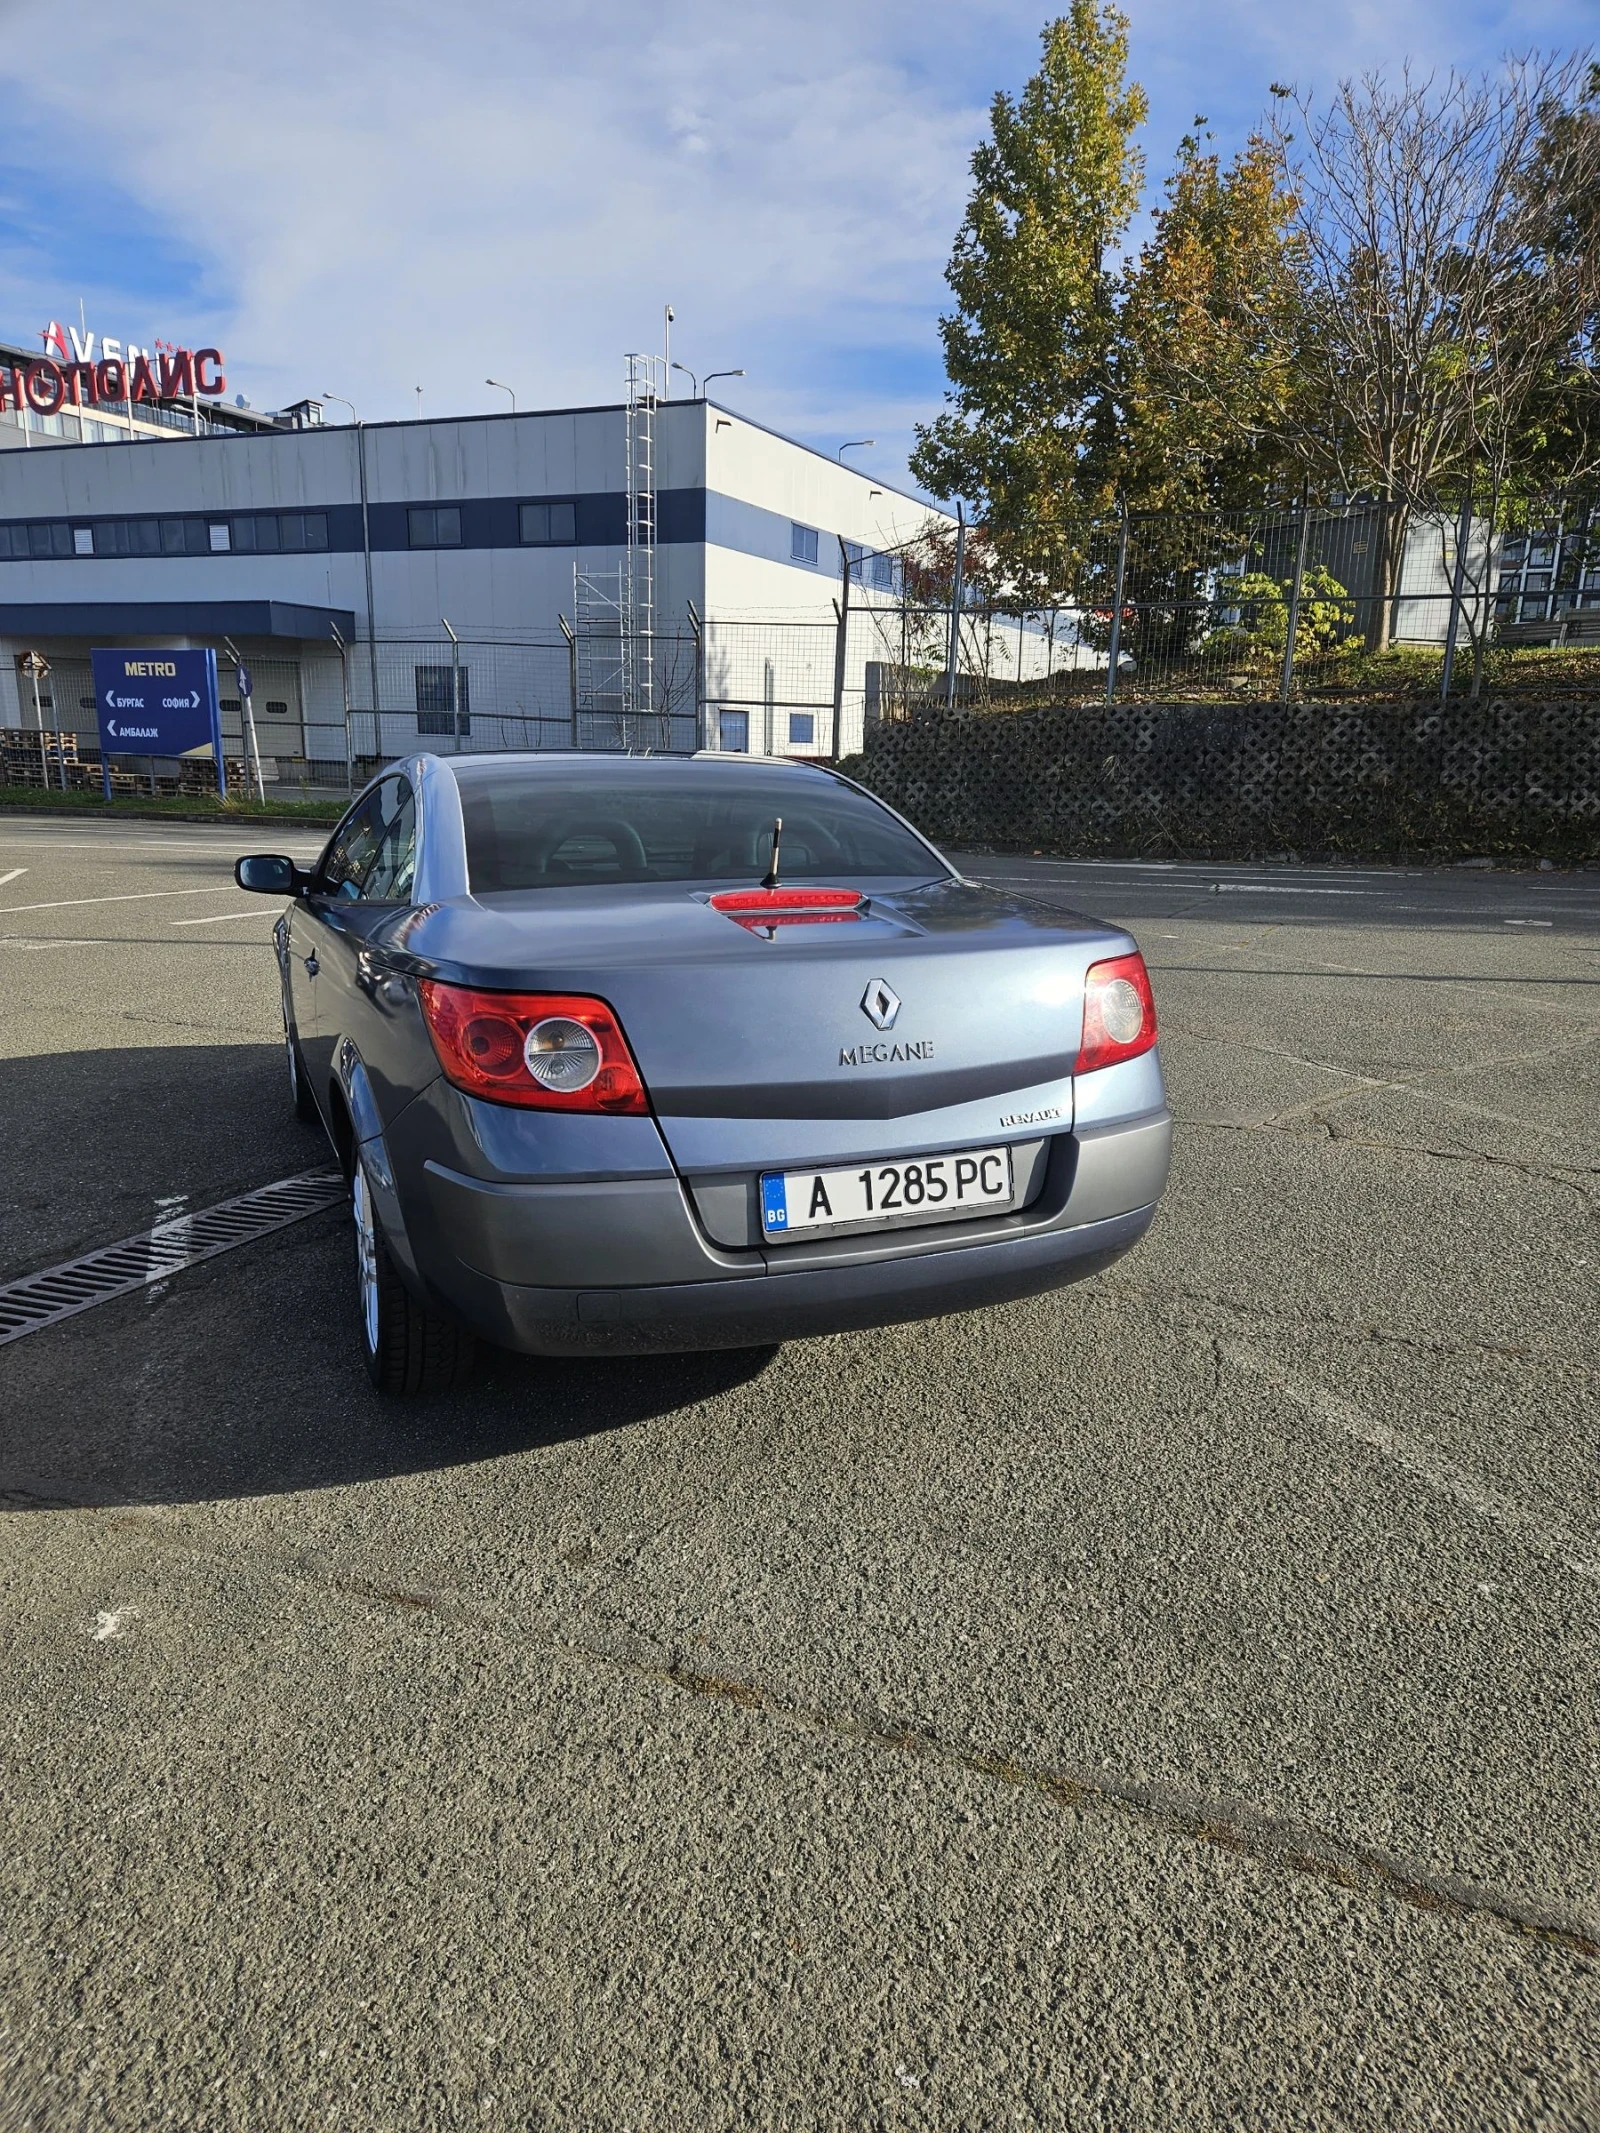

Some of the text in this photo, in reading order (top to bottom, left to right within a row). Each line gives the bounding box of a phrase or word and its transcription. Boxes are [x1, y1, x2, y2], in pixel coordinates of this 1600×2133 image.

[124, 662, 176, 676] METRO
[116, 697, 190, 708] БУРГАС СОФИЯ
[119, 727, 158, 737] АМБАЛАЖ
[838, 1040, 935, 1067] MEGANE
[999, 1106, 1063, 1128] RENAULT
[808, 1175, 833, 1219] A
[766, 1208, 787, 1224] BG
